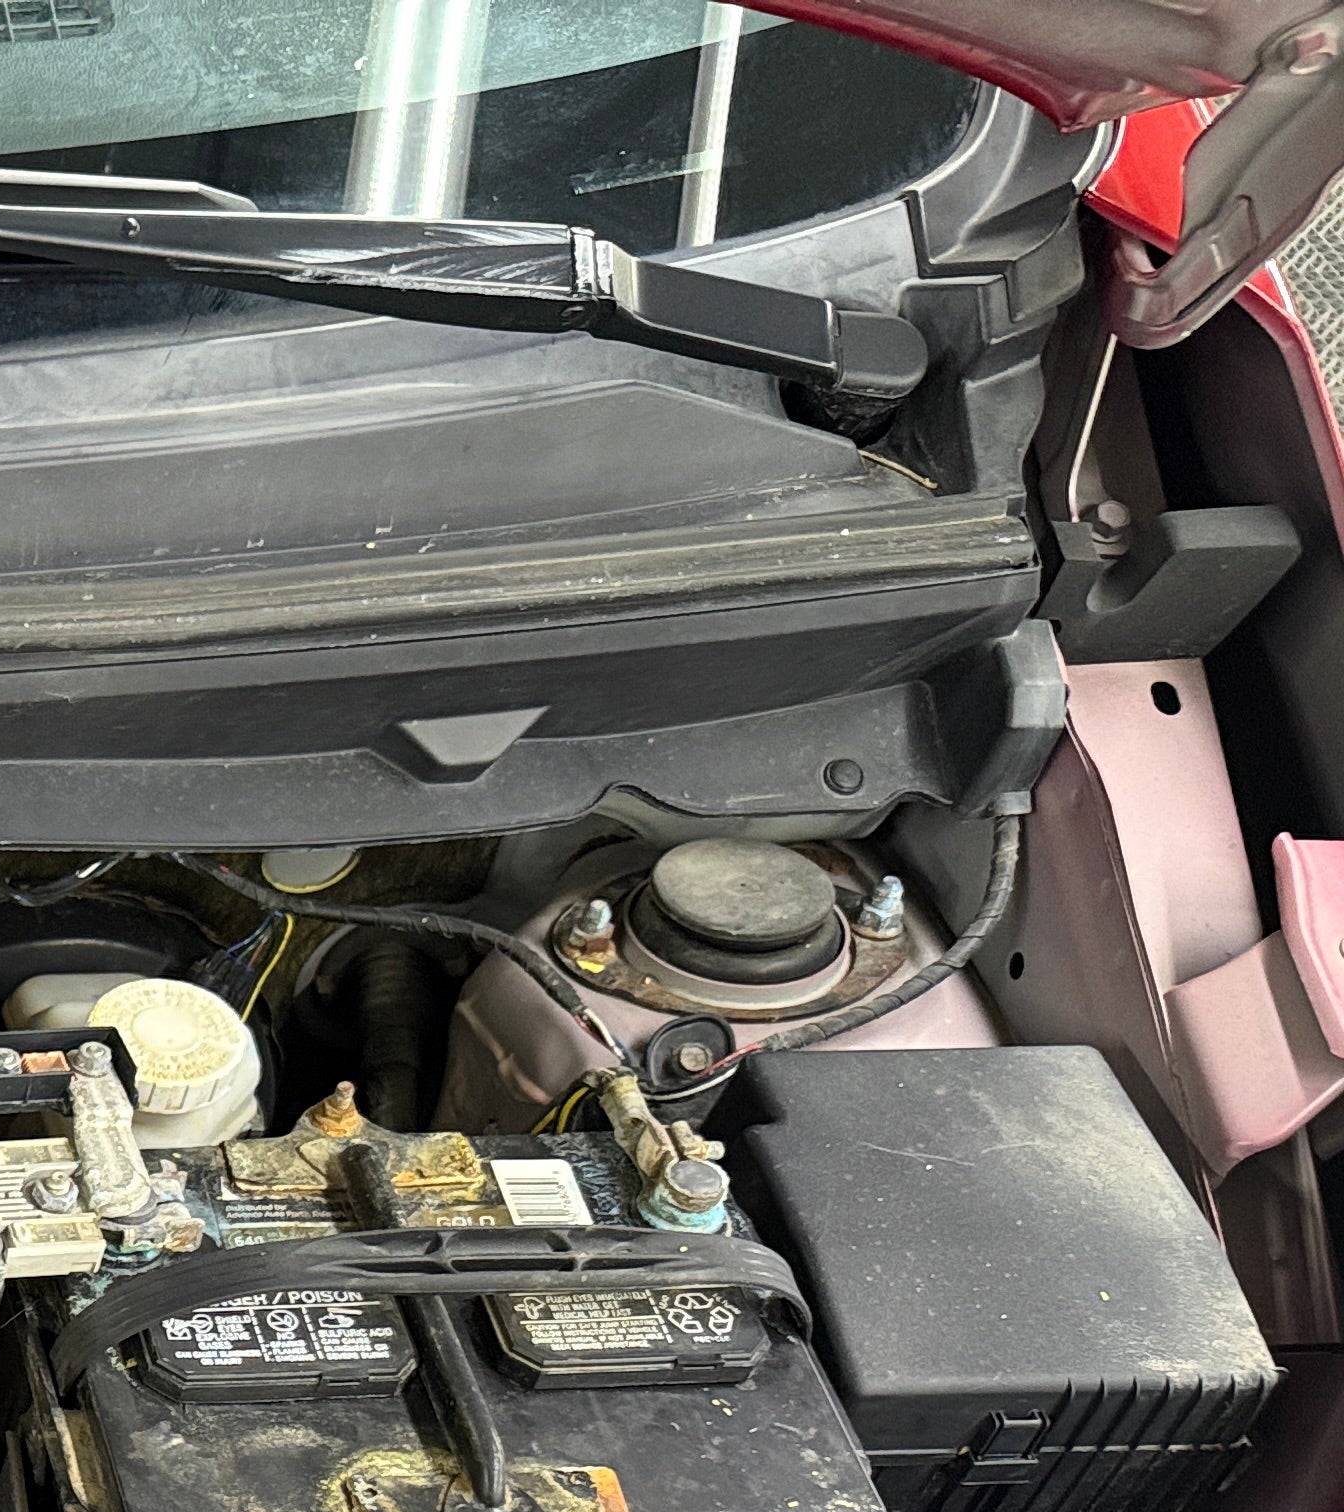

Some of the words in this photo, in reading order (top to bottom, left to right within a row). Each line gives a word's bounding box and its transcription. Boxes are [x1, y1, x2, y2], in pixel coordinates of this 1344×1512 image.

[287, 1290, 364, 1304] POISON
[276, 1332, 296, 1340] NO
[369, 1327, 393, 1337] ACID
